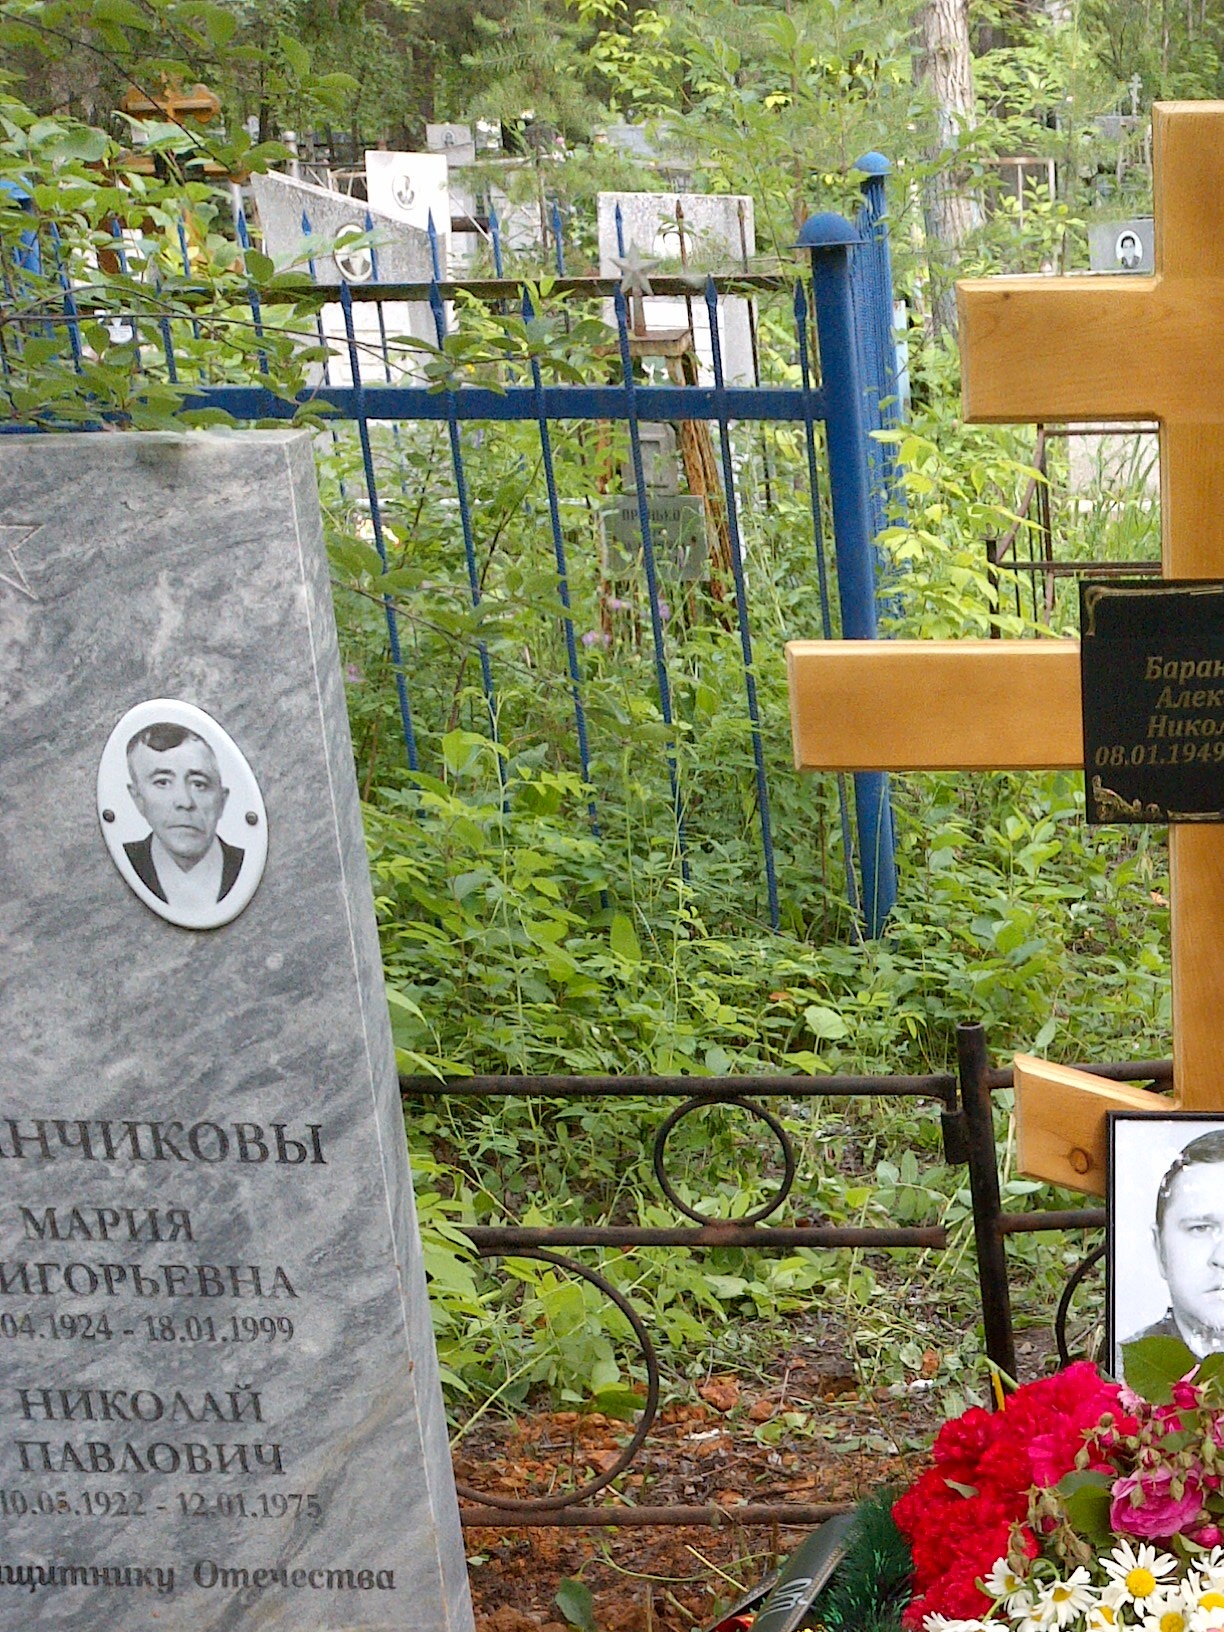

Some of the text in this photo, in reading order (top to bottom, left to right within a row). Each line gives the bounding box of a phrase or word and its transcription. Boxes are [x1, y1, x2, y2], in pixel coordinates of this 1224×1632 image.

[0, 1119, 328, 1165] НЧИКОВЫ
[19, 1206, 196, 1242] МАРИЯ
[0, 1262, 299, 1299] ИГОРЬЕВНА
[145, 1315, 294, 1344] 18.01.1999
[15, 1383, 266, 1425] НИКОЛАЙ
[14, 1441, 287, 1477] ПАВЛОВИЧ
[175, 1492, 322, 1520] 12.01.1975
[192, 1560, 396, 1592] Отечества
